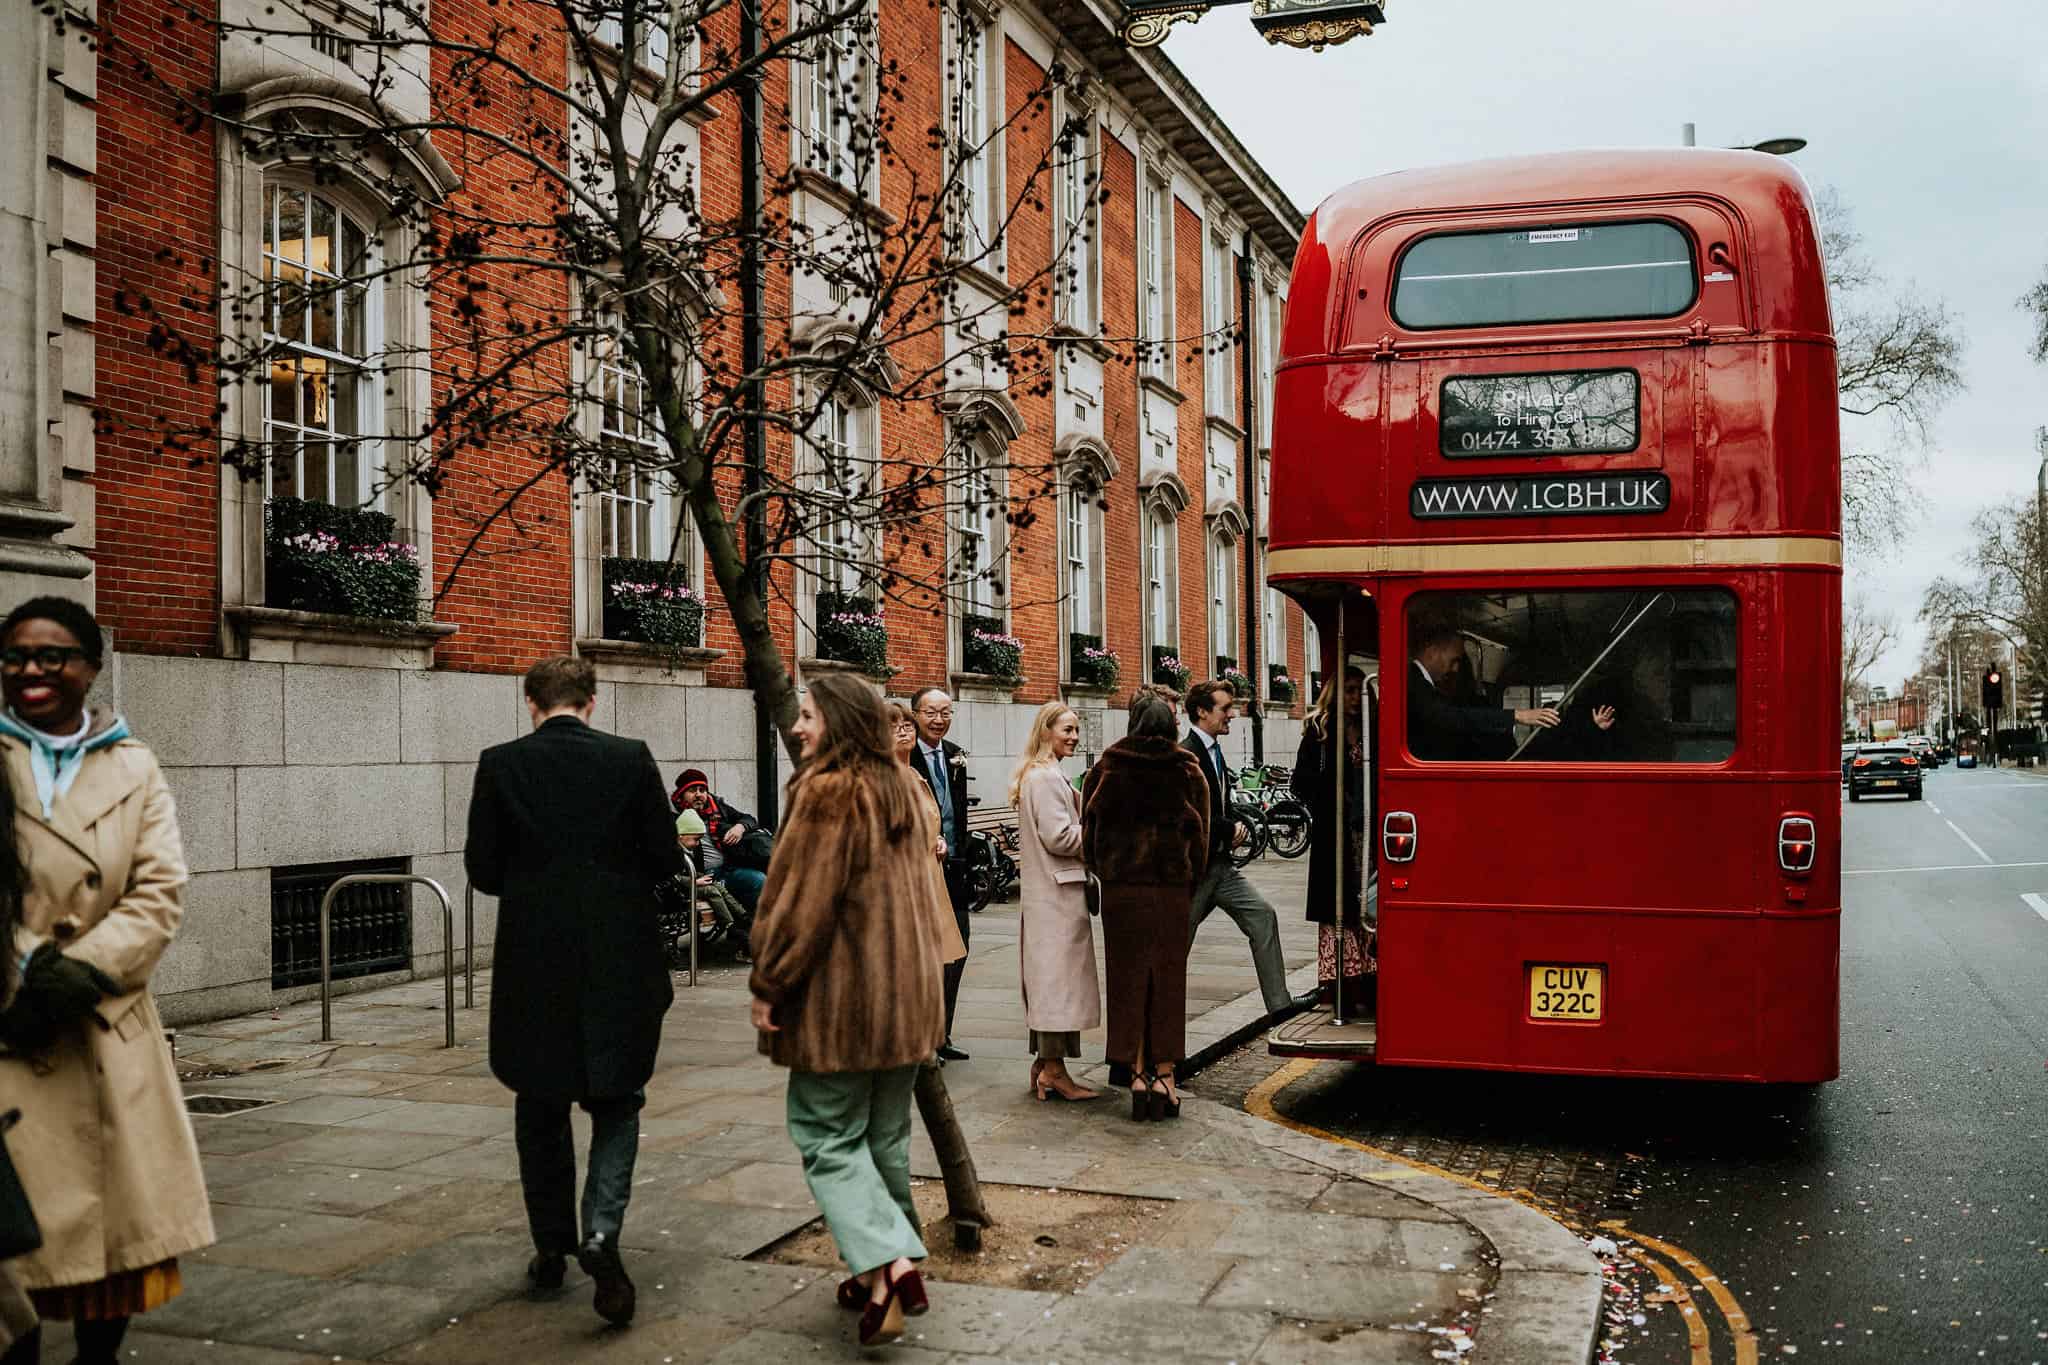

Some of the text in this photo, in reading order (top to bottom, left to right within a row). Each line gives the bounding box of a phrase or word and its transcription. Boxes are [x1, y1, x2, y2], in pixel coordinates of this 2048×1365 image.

[1502, 391, 1577, 408] Private
[1496, 410, 1583, 426] To Hire Call
[1461, 431, 1521, 450] 01474
[1545, 969, 1588, 990] CUV
[1537, 992, 1595, 1013] 322C
